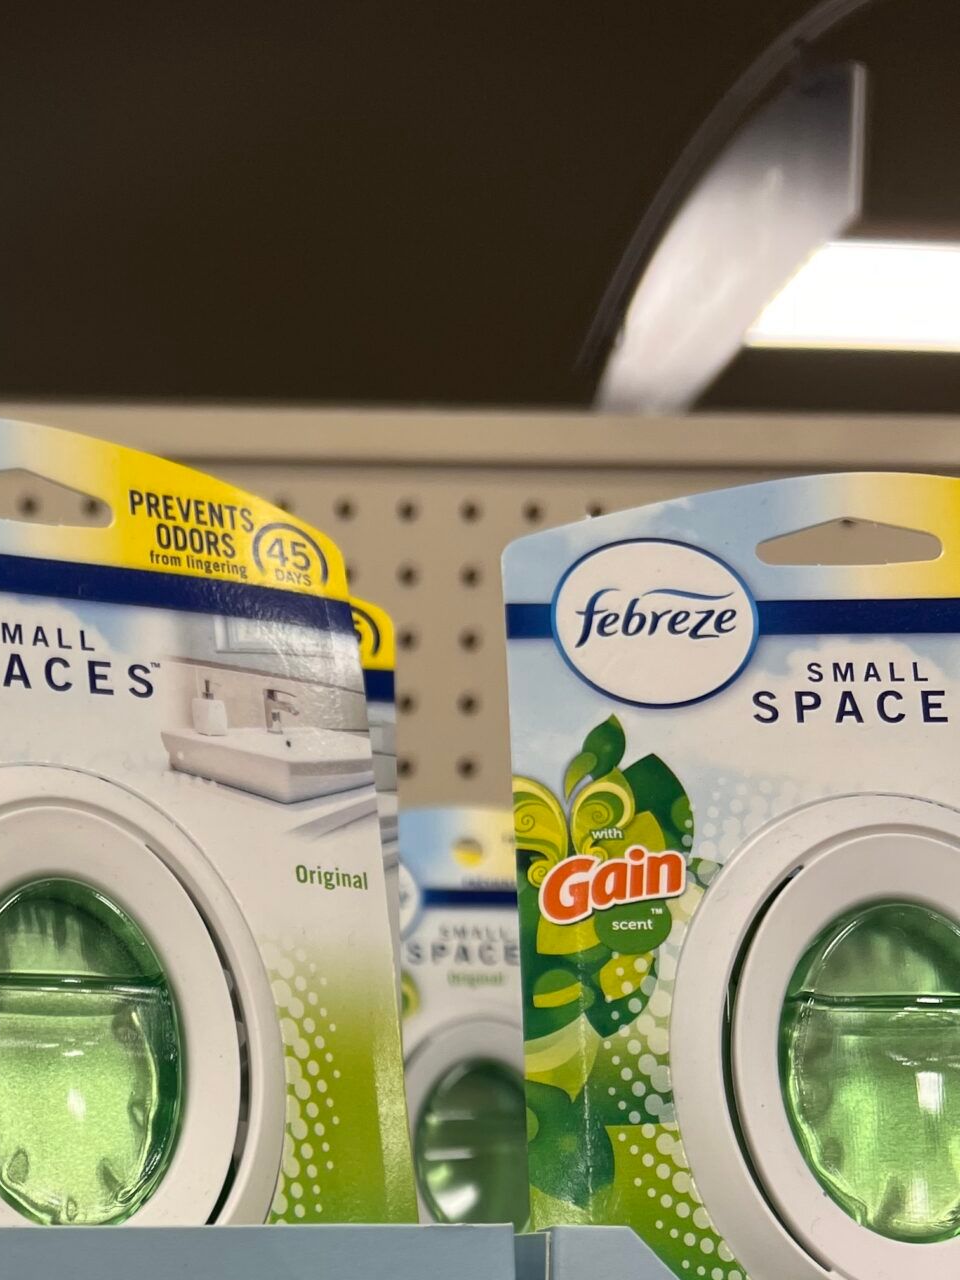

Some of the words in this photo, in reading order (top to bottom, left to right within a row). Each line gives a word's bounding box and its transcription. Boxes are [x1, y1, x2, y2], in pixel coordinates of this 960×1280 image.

[129, 490, 254, 533] PREVENTS
[157, 523, 236, 559] ODORS
[267, 538, 312, 571] 45
[150, 550, 182, 567] from
[186, 554, 248, 580] lingering
[275, 568, 313, 587] DAYS
[575, 587, 738, 648] febreze
[807, 661, 929, 683] SMALL
[591, 828, 623, 840] with
[295, 864, 369, 891] Original
[542, 847, 684, 922] Gain
[612, 917, 653, 931] scent
